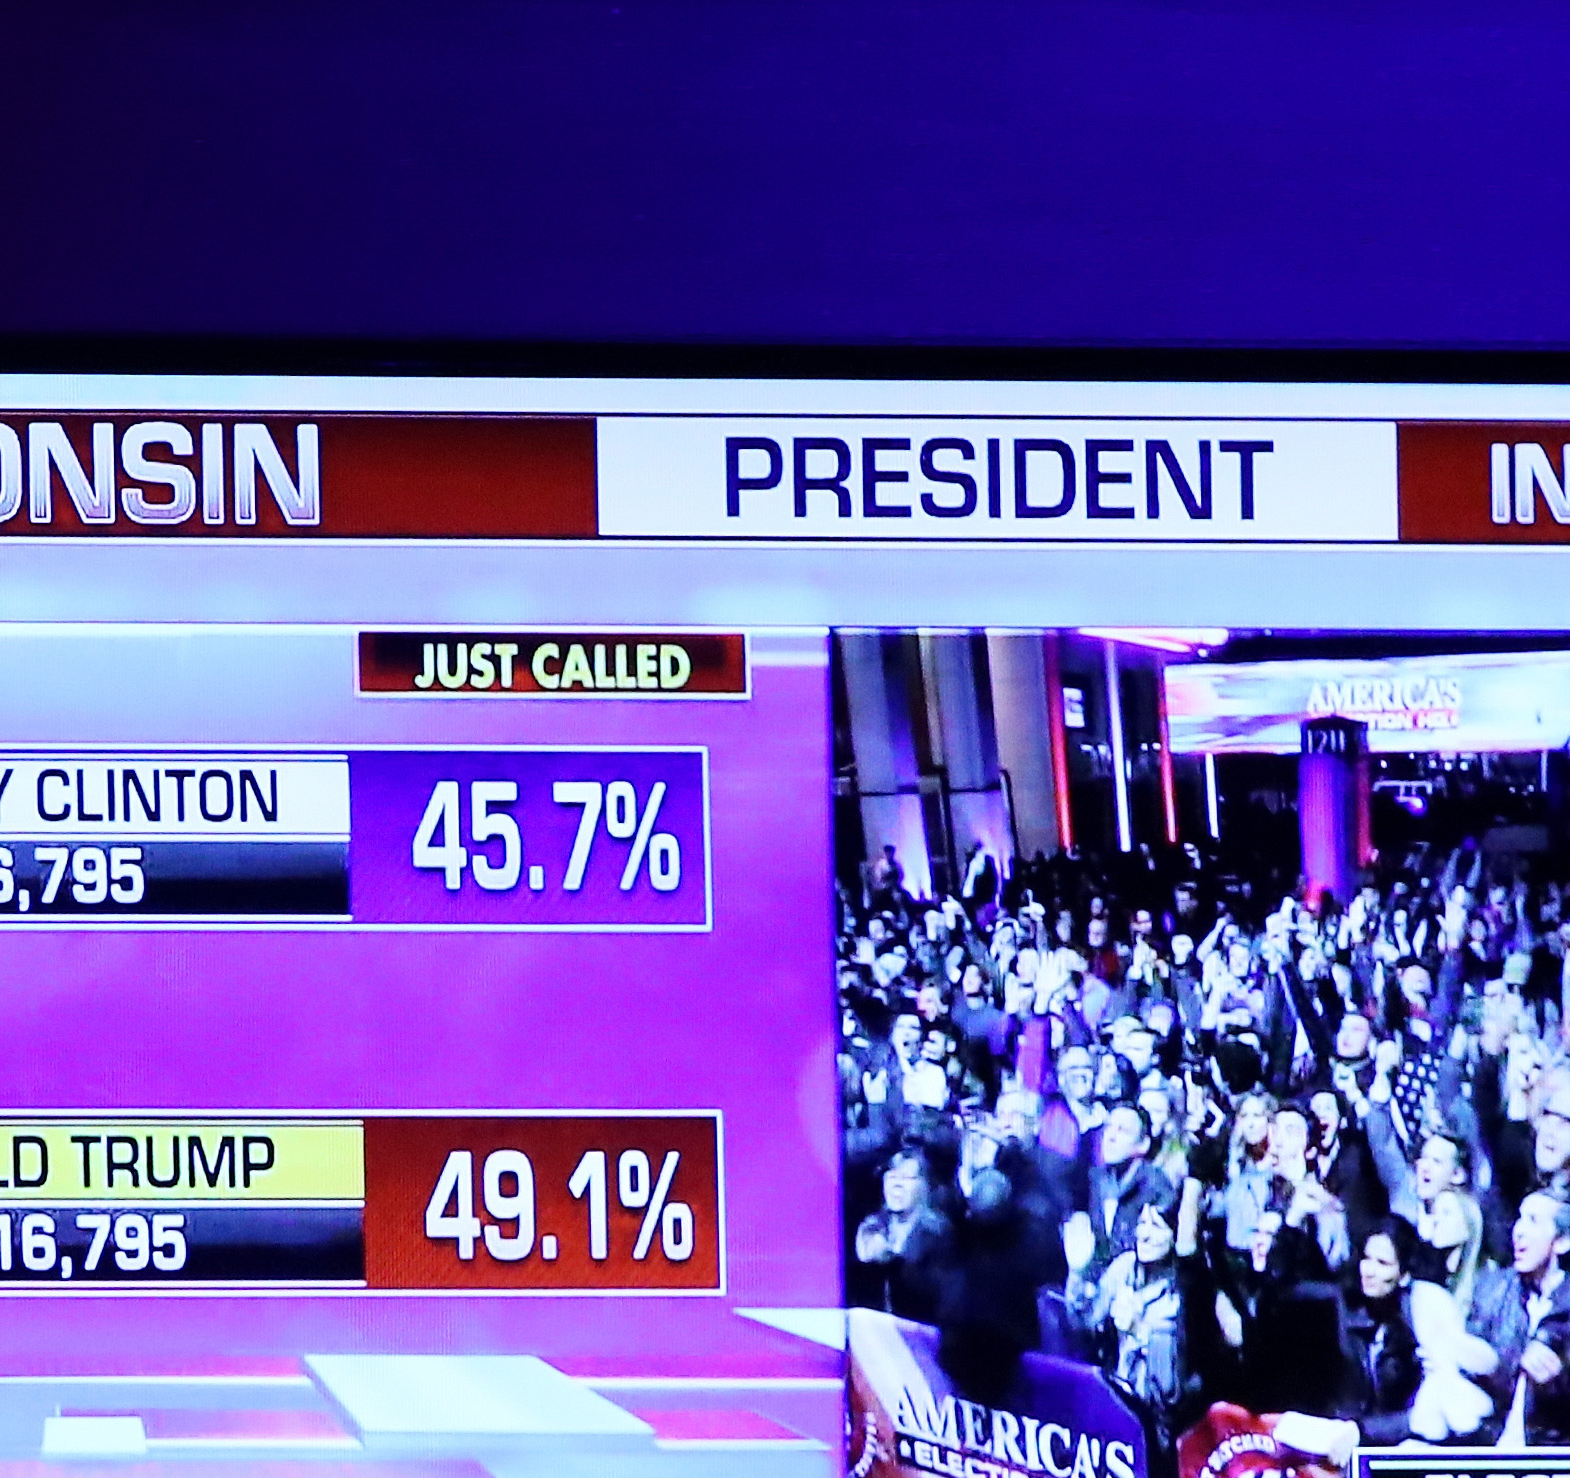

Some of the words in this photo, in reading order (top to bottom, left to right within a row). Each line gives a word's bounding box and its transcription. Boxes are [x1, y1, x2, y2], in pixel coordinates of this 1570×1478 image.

[725, 437, 1274, 521] PRESIDENT
[414, 643, 519, 690] JUST
[531, 644, 692, 690] CALLED
[1306, 677, 1462, 713] AMERICA'S
[35, 768, 278, 823] CLINTON
[412, 780, 681, 892] 45.7%
[72, 1135, 275, 1189] TRUMP
[425, 1150, 695, 1262] 49.1%
